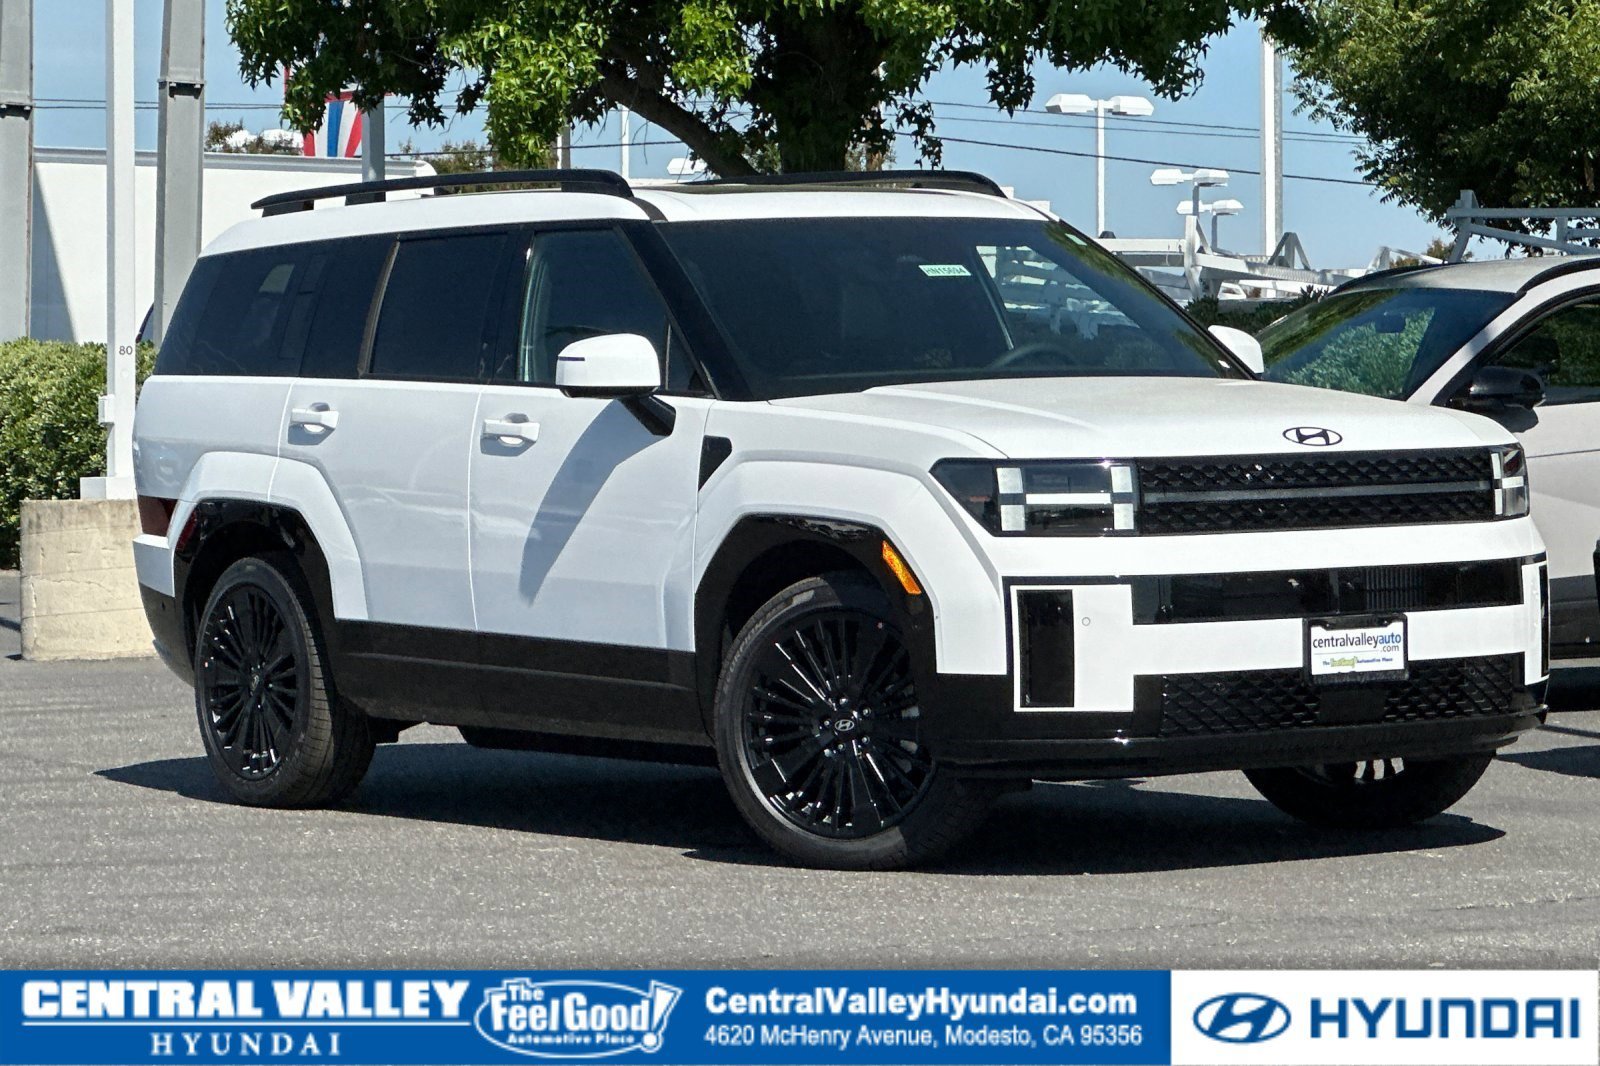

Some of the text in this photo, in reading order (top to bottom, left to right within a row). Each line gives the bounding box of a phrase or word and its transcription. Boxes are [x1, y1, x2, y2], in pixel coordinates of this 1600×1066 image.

[119, 345, 133, 356] 80
[1312, 632, 1402, 648] centralvalleyauto
[1380, 644, 1400, 653] .com
